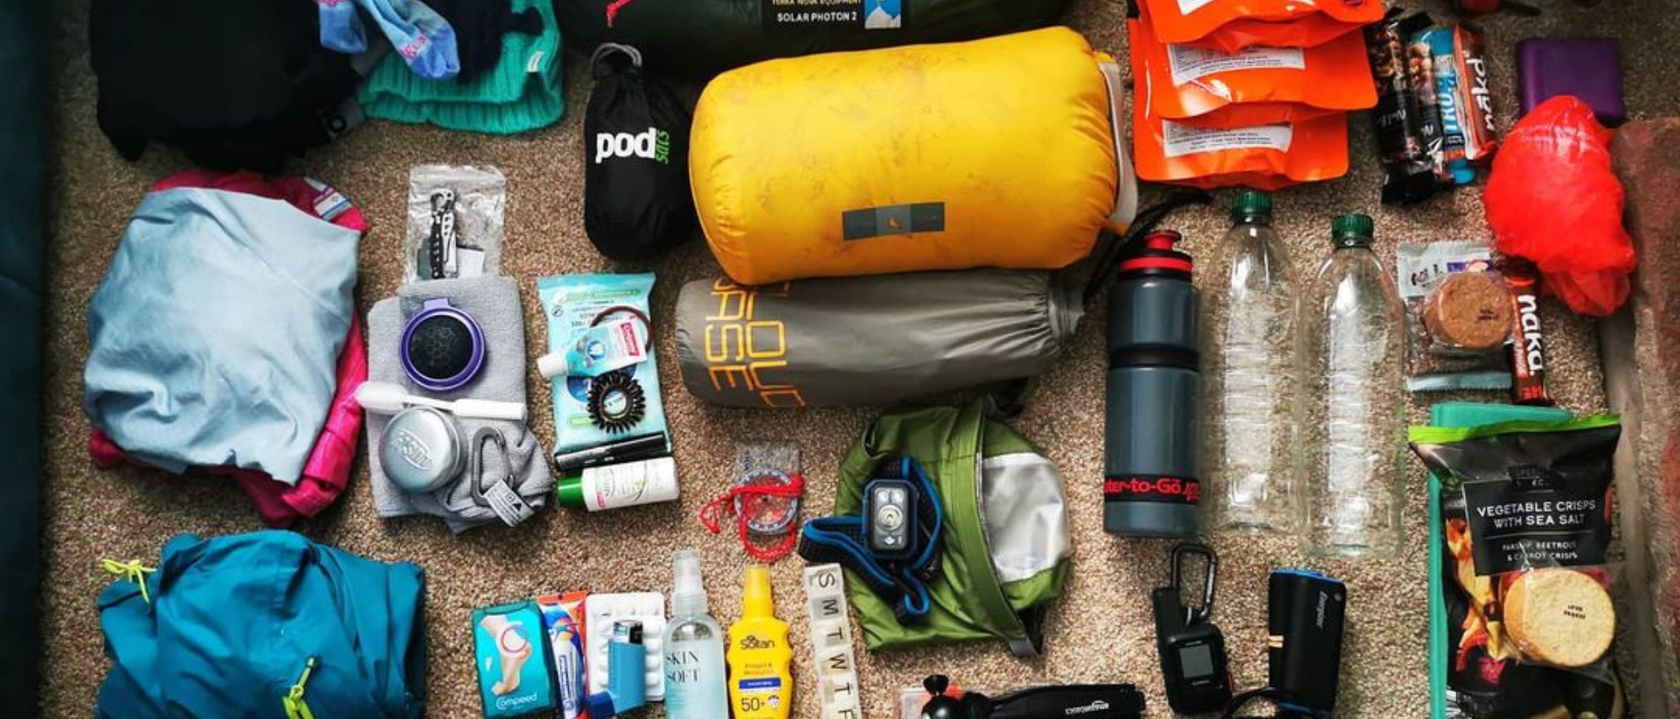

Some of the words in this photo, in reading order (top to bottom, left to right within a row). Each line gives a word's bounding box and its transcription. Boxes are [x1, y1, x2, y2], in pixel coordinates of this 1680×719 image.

[777, 13, 810, 22] SOLAR
[811, 12, 850, 21] PHOTON
[851, 11, 857, 21] 2
[595, 127, 657, 164] pod
[1476, 501, 1552, 517] VEGETABLE
[1556, 499, 1596, 511] CRISPS
[1494, 514, 1523, 528] WITH
[1525, 514, 1555, 526] SEA
[1559, 513, 1584, 525] SALT
[819, 572, 836, 588] S
[822, 599, 839, 616] M
[827, 626, 843, 640] T
[740, 635, 775, 650] Soltan
[667, 651, 699, 665] SKIN
[829, 653, 847, 670] W
[667, 668, 701, 684] SOFT
[834, 682, 851, 695] T
[741, 697, 765, 712] 50+
